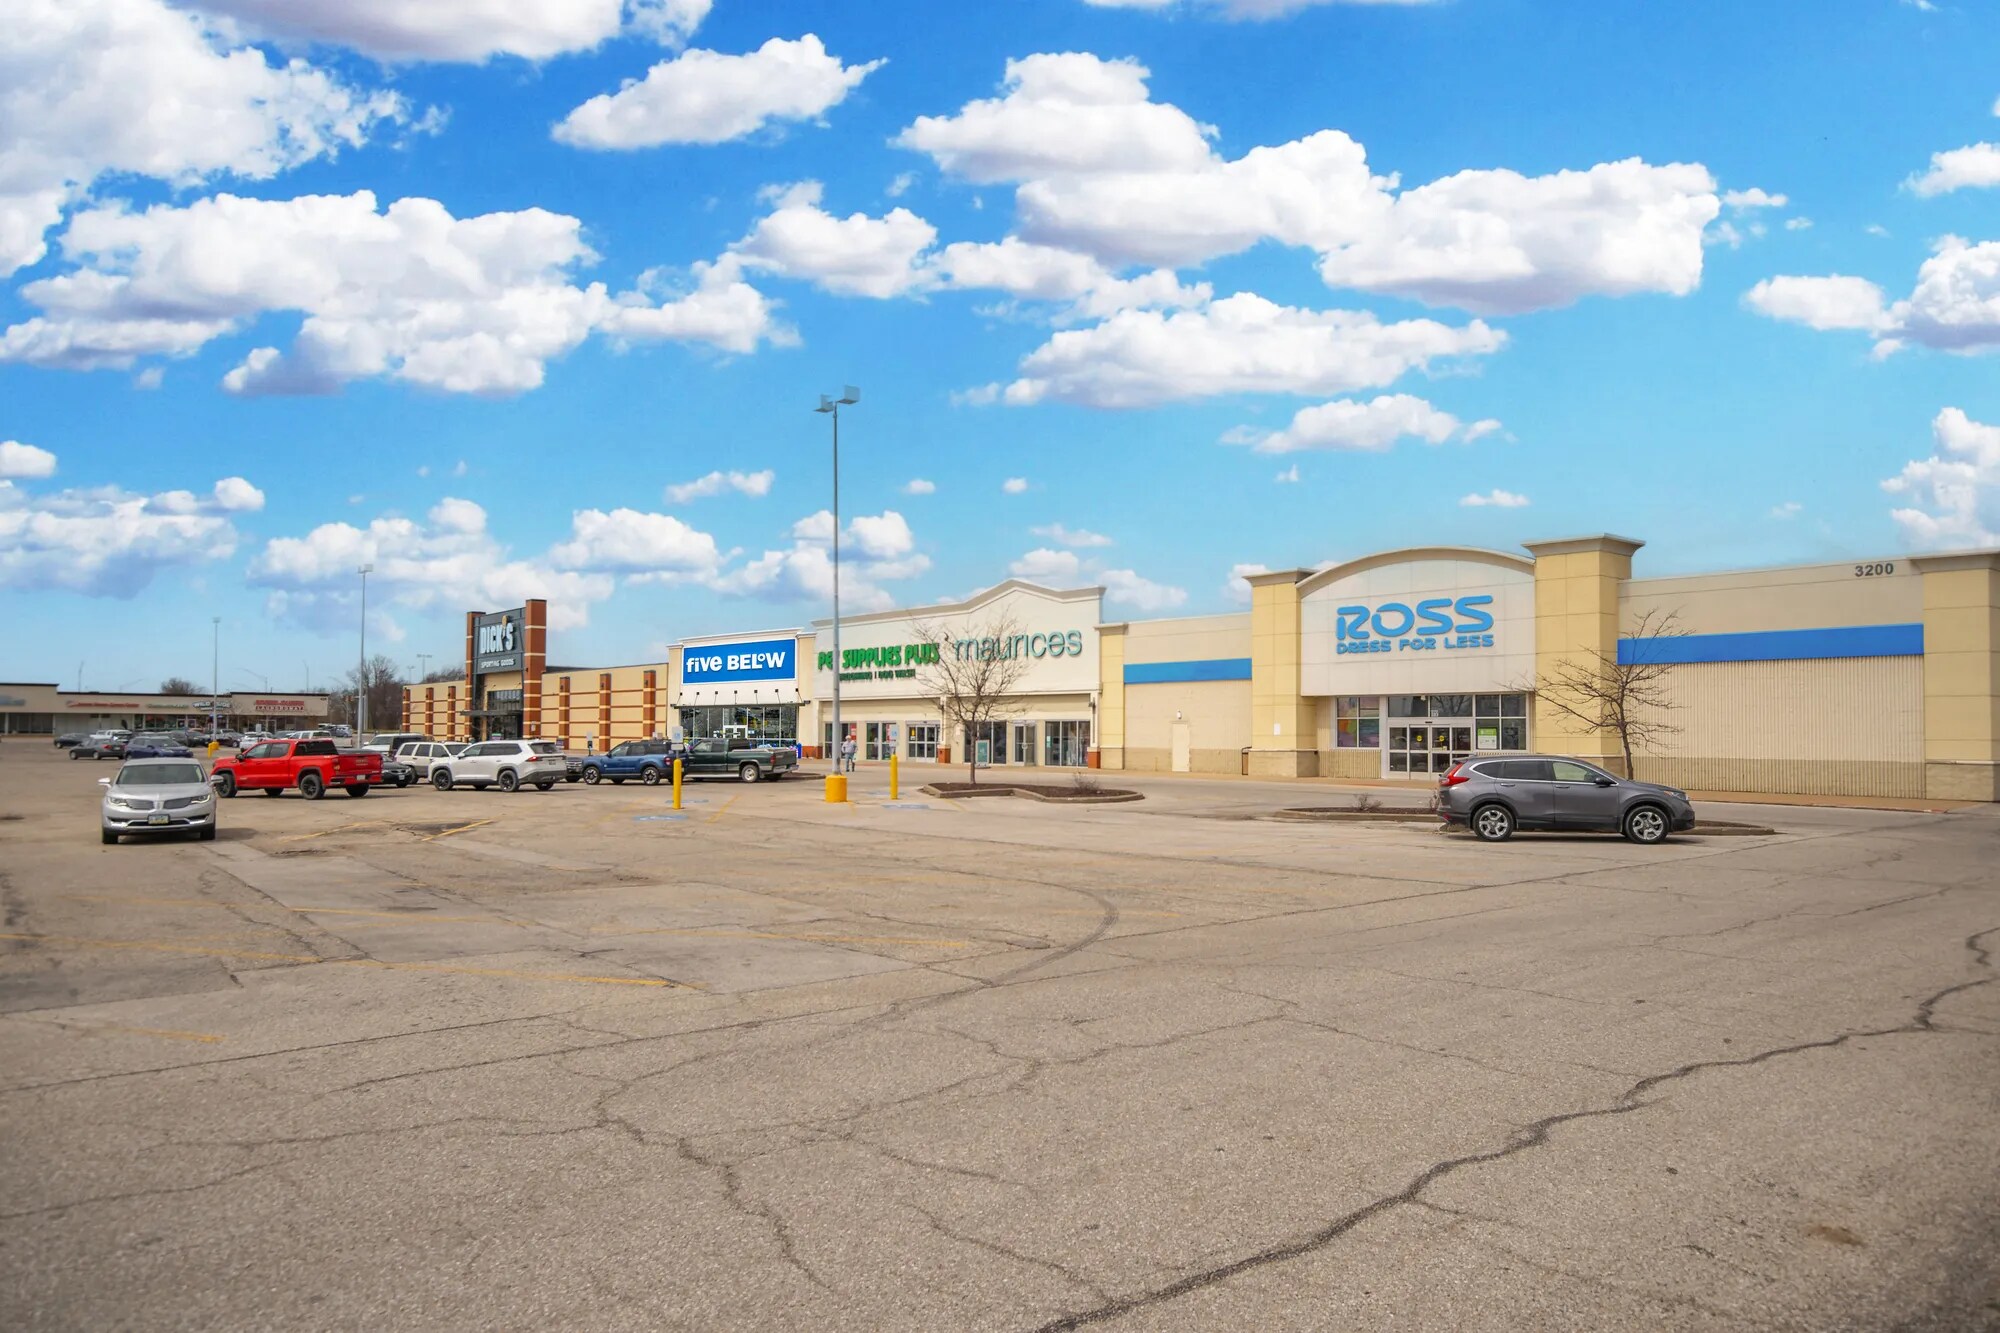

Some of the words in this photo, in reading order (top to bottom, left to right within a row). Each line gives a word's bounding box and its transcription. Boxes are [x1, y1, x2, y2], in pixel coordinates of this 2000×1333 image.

[1855, 563, 1894, 577] 3200
[1336, 595, 1494, 640] ROSS
[480, 617, 513, 654] DICK'S
[955, 630, 1083, 662] maurices
[1336, 640, 1391, 654] DRESS
[1399, 637, 1436, 651] FOR
[1444, 634, 1494, 649] LESS
[686, 656, 723, 673] five
[817, 651, 833, 670] PE
[842, 646, 902, 669] SUPPLIES
[904, 643, 940, 665] PLUS
